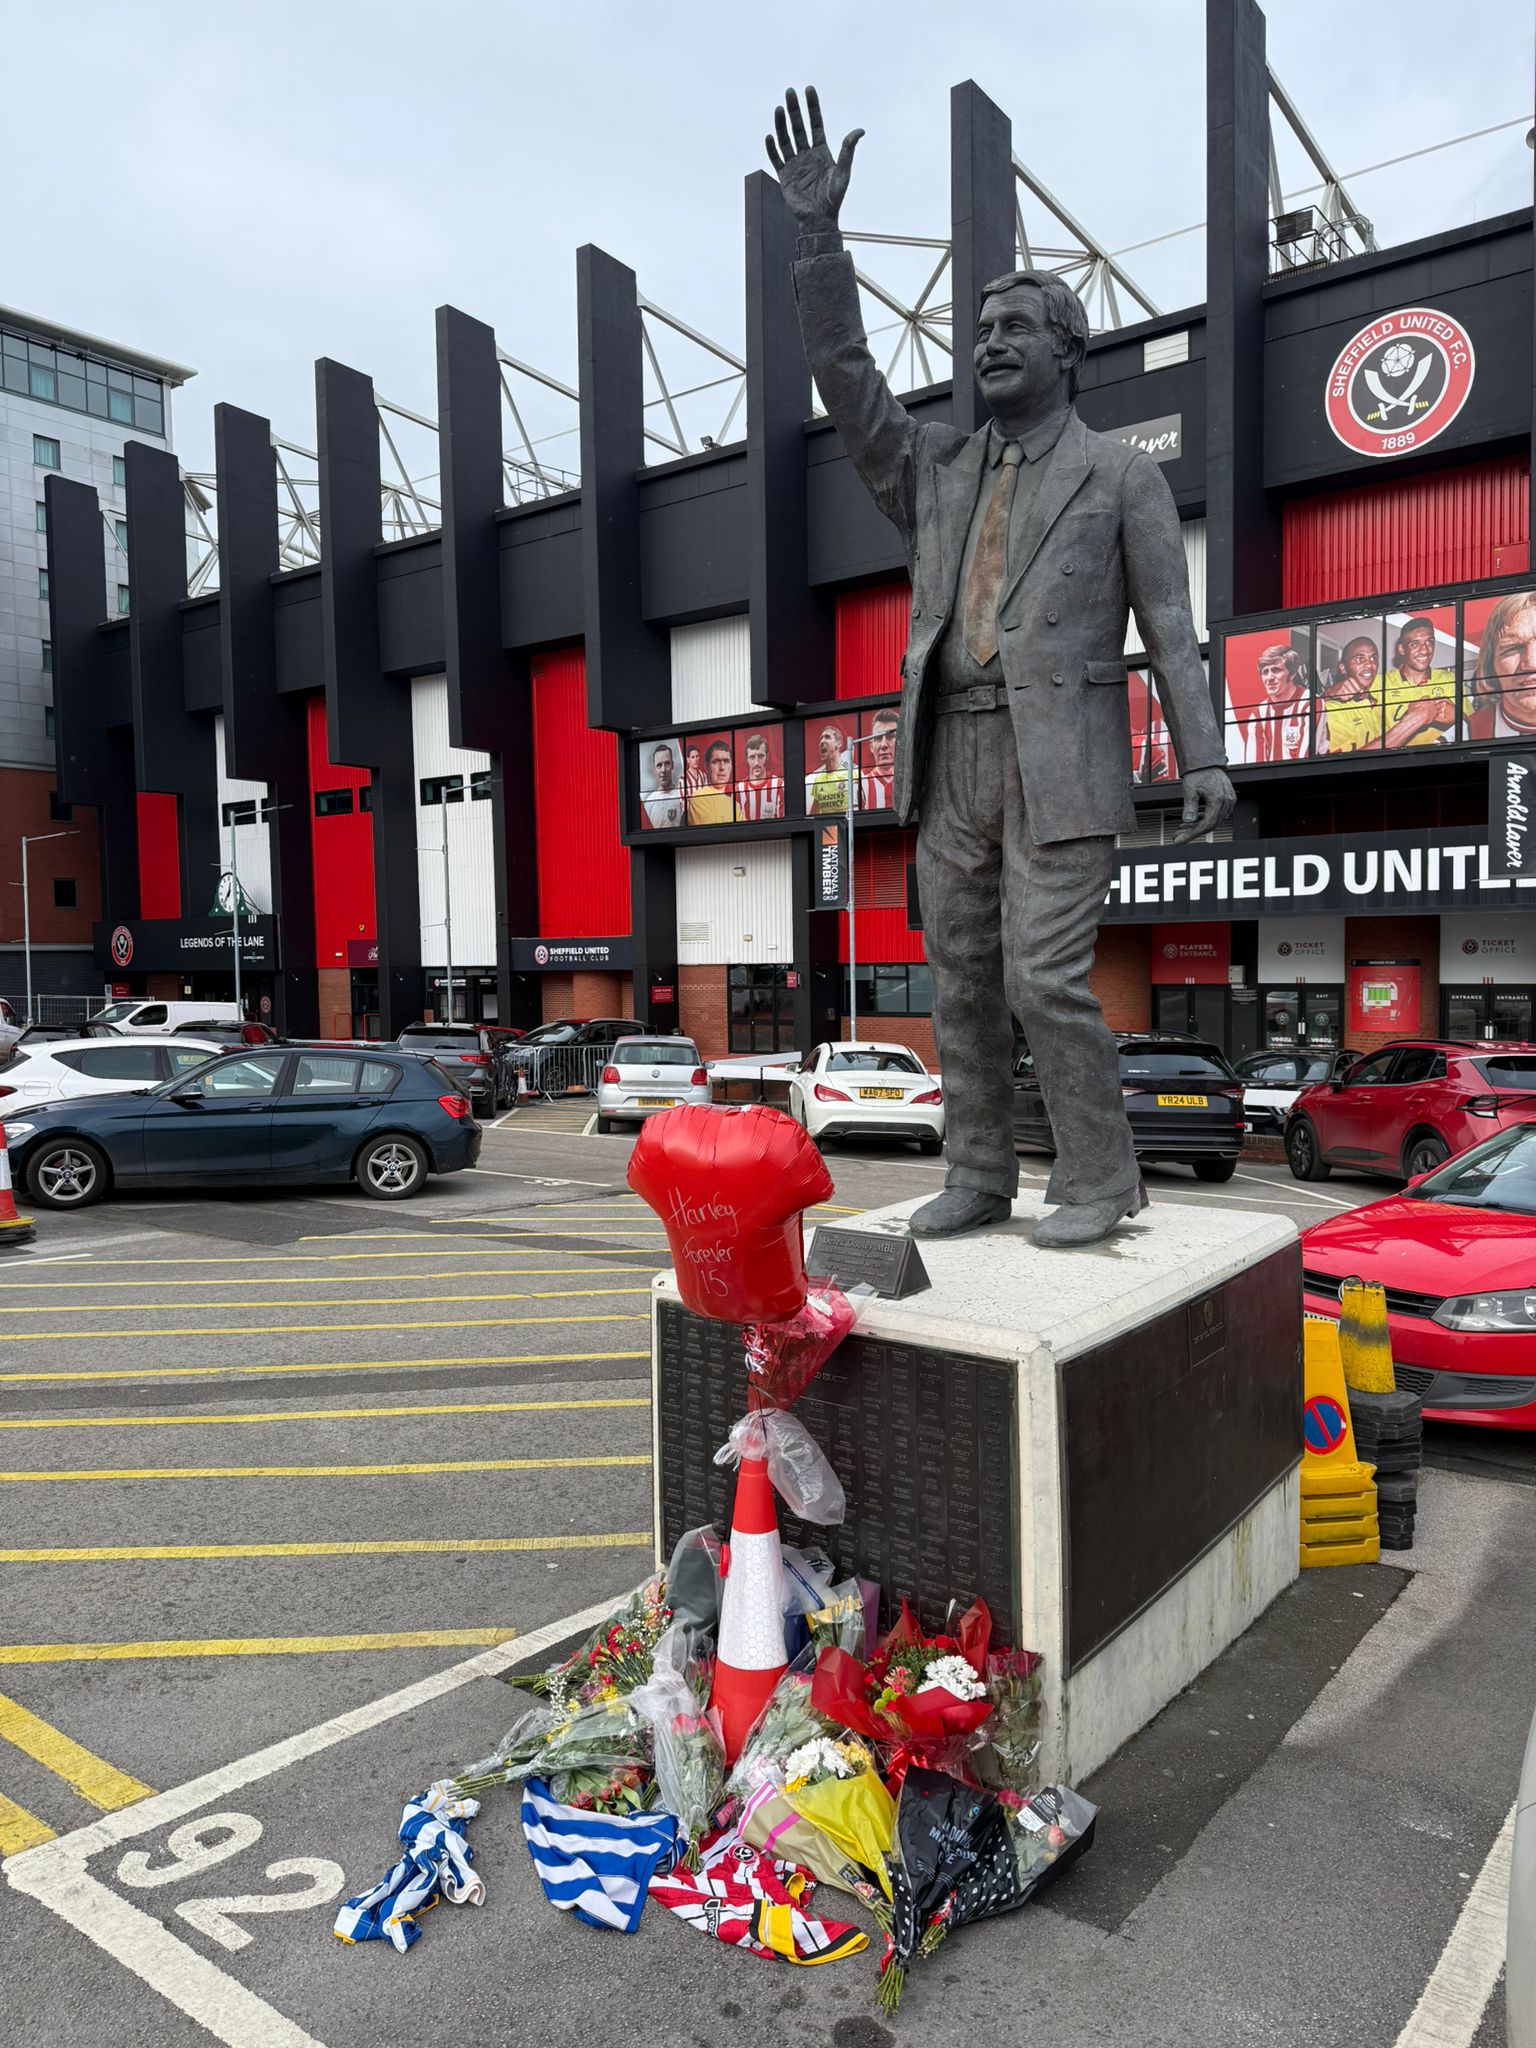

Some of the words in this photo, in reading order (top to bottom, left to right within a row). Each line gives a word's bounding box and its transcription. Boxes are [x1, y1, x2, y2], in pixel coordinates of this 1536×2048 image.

[1333, 322, 1393, 397] SHEFFIELD
[1400, 315, 1454, 341] UNITED
[1449, 340, 1467, 369] F.C.
[1381, 432, 1416, 450] 1889
[1506, 762, 1529, 821] Arnold
[1506, 823, 1529, 868] Laver
[822, 846, 832, 895] TIMBER
[1104, 854, 1331, 904] HEFFIELD
[180, 937, 214, 948] LEGENDS
[215, 937, 226, 948] OF
[243, 936, 264, 947] LANE
[550, 947, 583, 955] SHEFFIELD
[584, 946, 609, 954] UNITED
[1161, 1095, 1185, 1104] YR24
[1186, 1096, 1204, 1105] ULB
[668, 1186, 742, 1237] Harvey
[682, 1236, 735, 1266] Forever
[700, 1268, 729, 1297] 15
